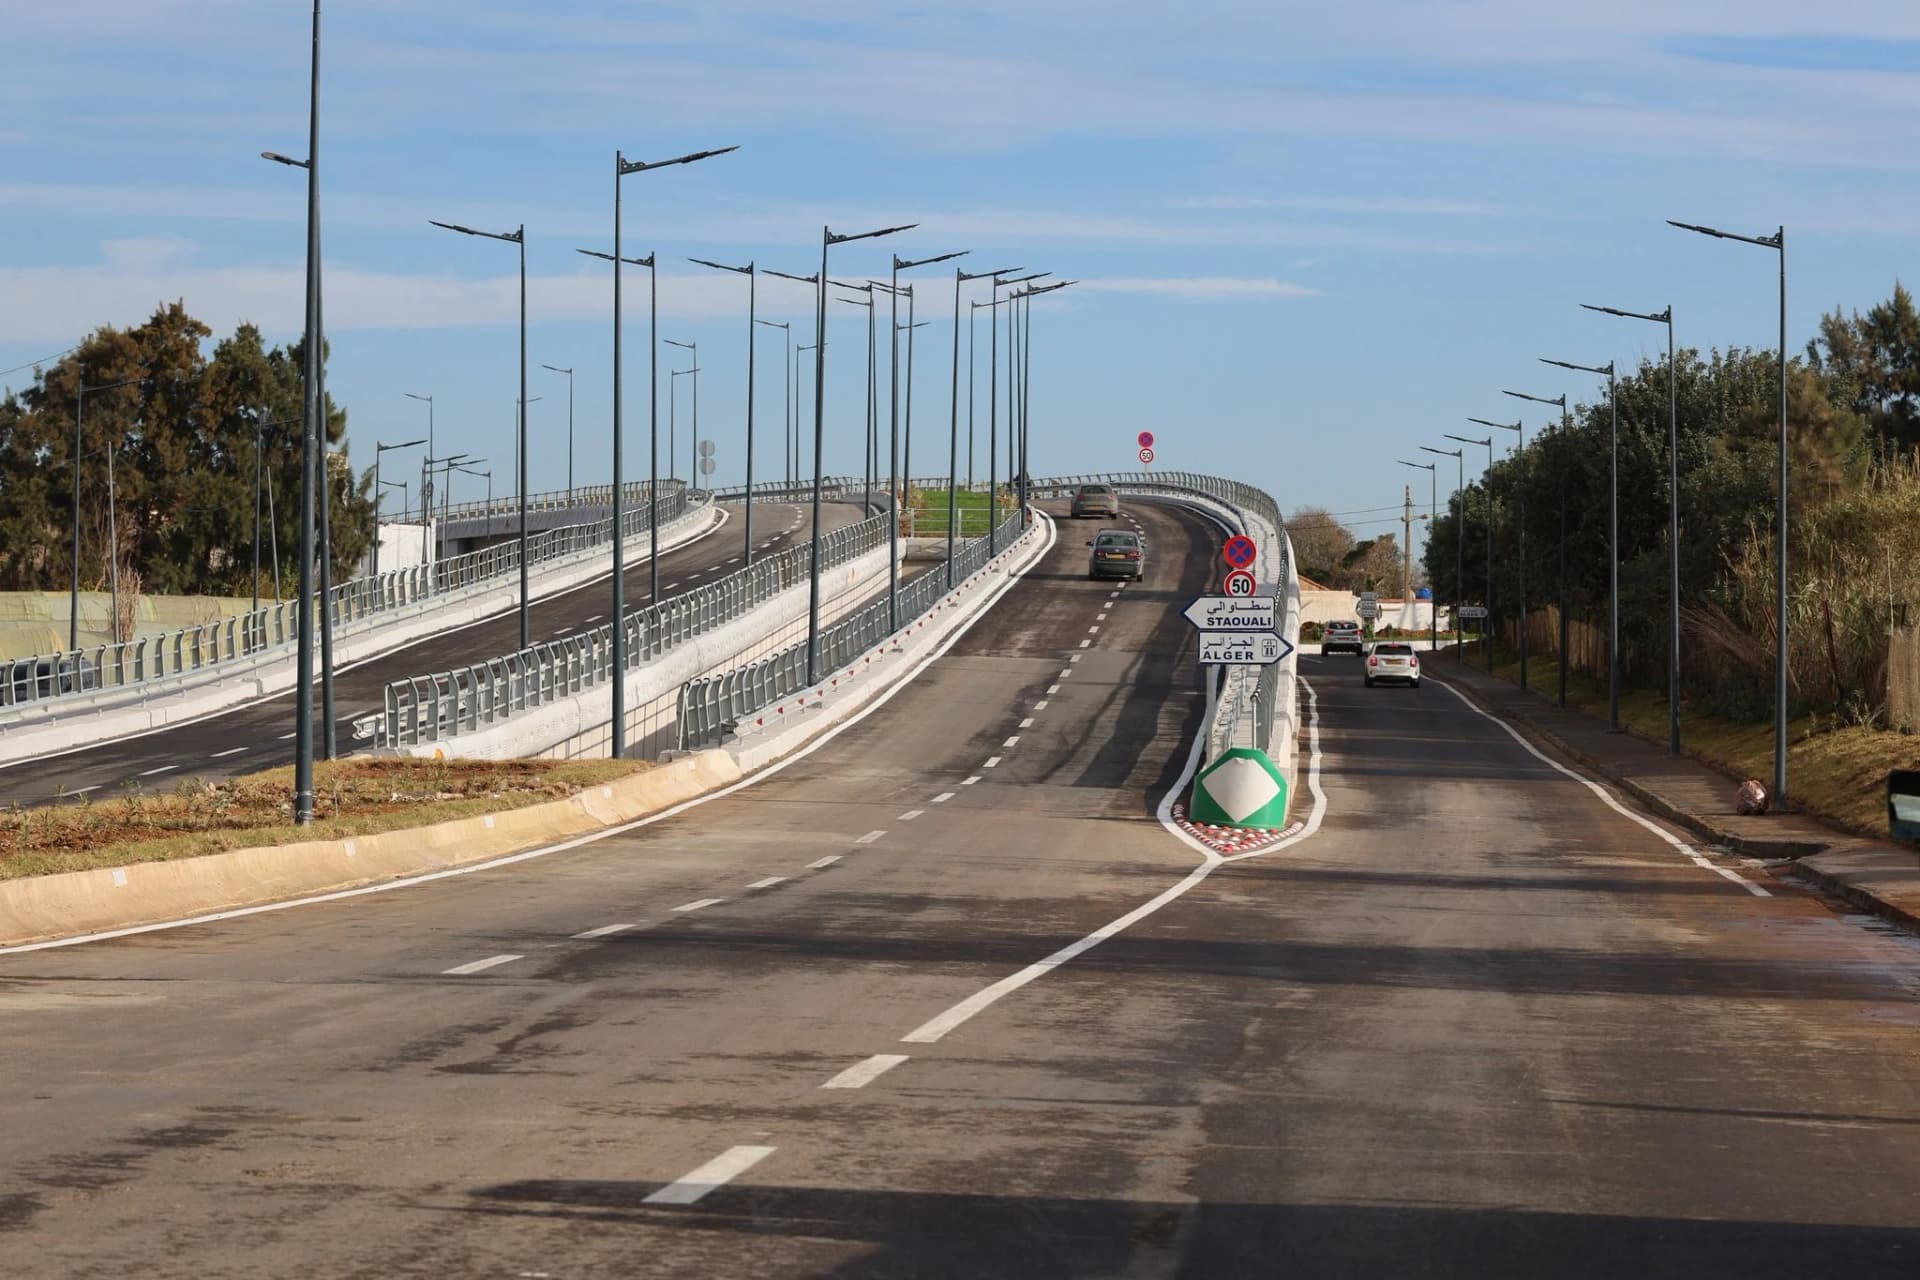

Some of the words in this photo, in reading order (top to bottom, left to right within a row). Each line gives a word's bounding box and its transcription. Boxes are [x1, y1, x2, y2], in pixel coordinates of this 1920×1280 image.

[1142, 452, 1151, 460] 50
[1232, 579, 1250, 594] 50
[1207, 617, 1271, 626] STAOUALI
[1203, 651, 1254, 660] ALGER
